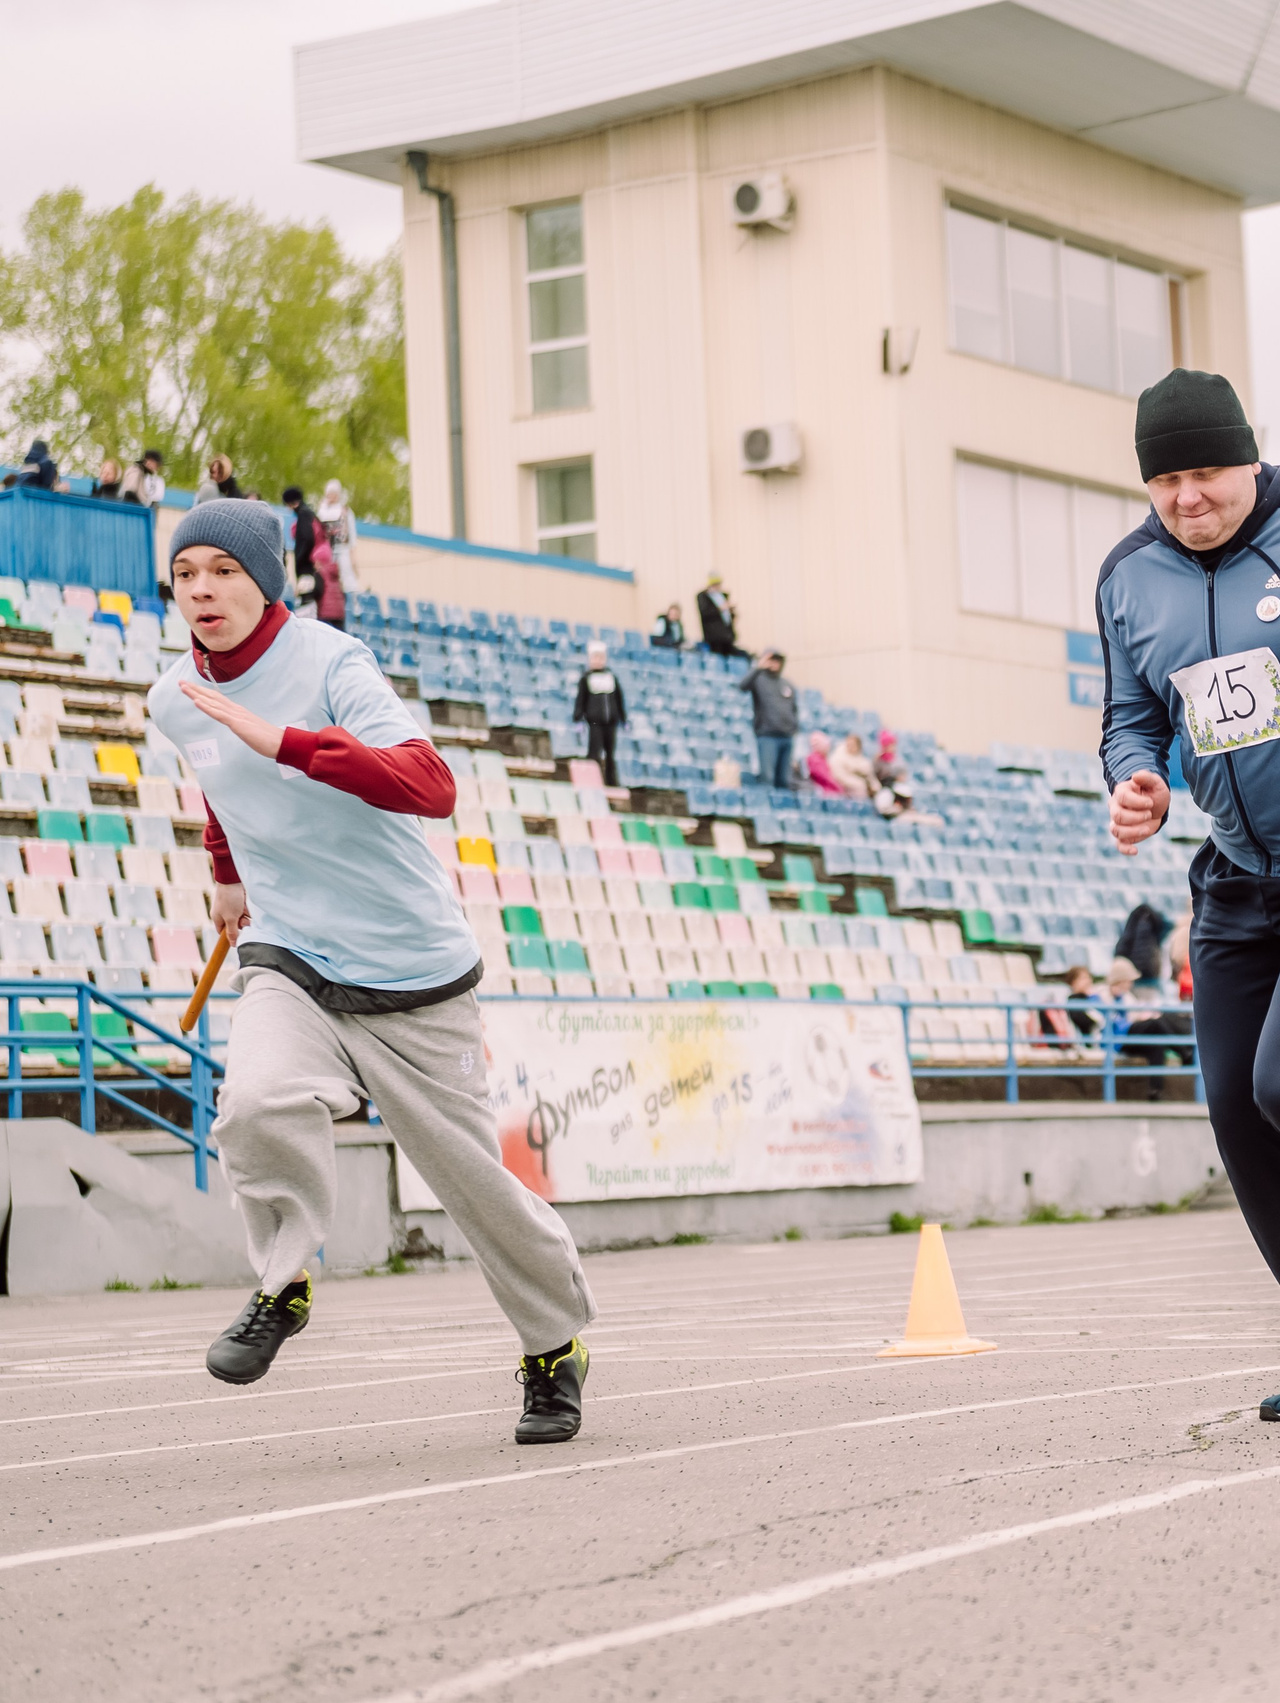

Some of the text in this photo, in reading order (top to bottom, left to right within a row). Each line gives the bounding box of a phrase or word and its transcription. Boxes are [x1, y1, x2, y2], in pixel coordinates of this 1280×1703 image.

[1207, 665, 1256, 724] 15
[558, 1008, 643, 1044] футболом
[647, 1013, 664, 1043] за
[644, 1060, 715, 1128] детей
[654, 1166, 671, 1183] на
